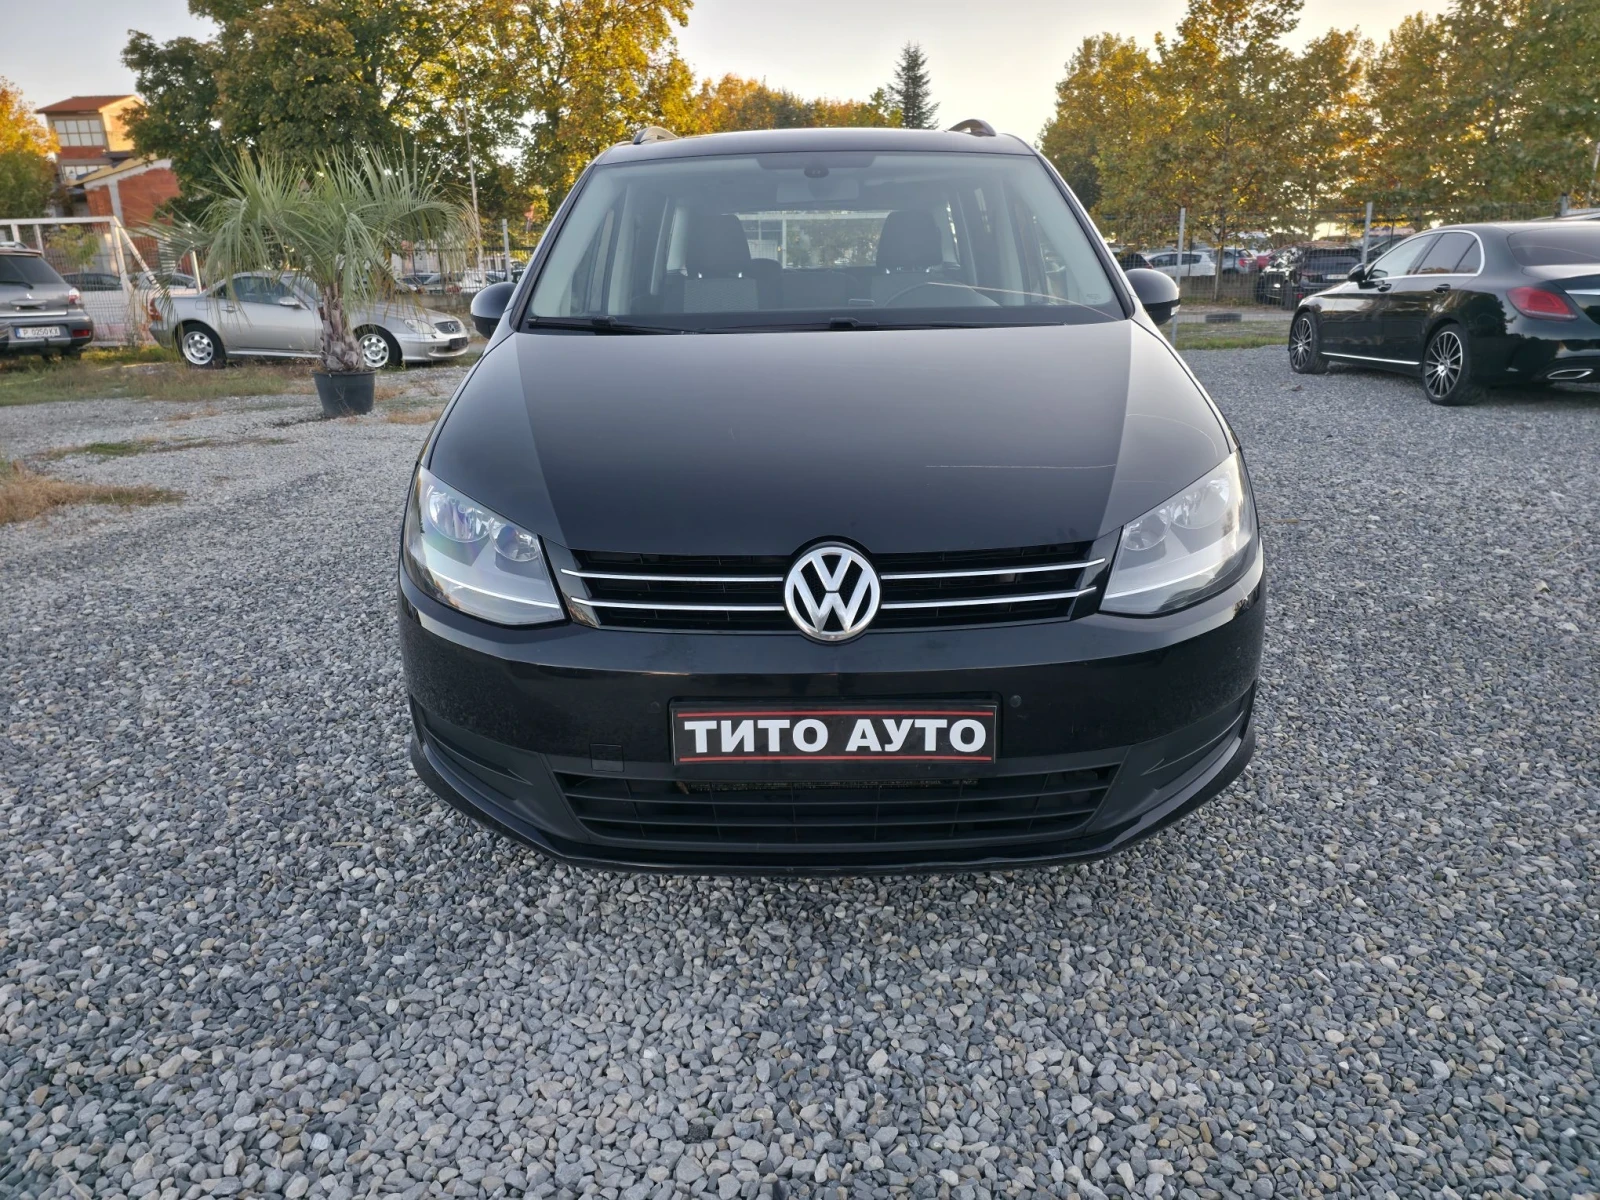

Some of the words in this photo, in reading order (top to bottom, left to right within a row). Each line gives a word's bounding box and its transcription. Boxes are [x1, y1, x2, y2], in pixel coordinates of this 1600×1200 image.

[786, 547, 879, 639] VW
[684, 719, 829, 753] ТИТО
[845, 718, 986, 752] АУТО
